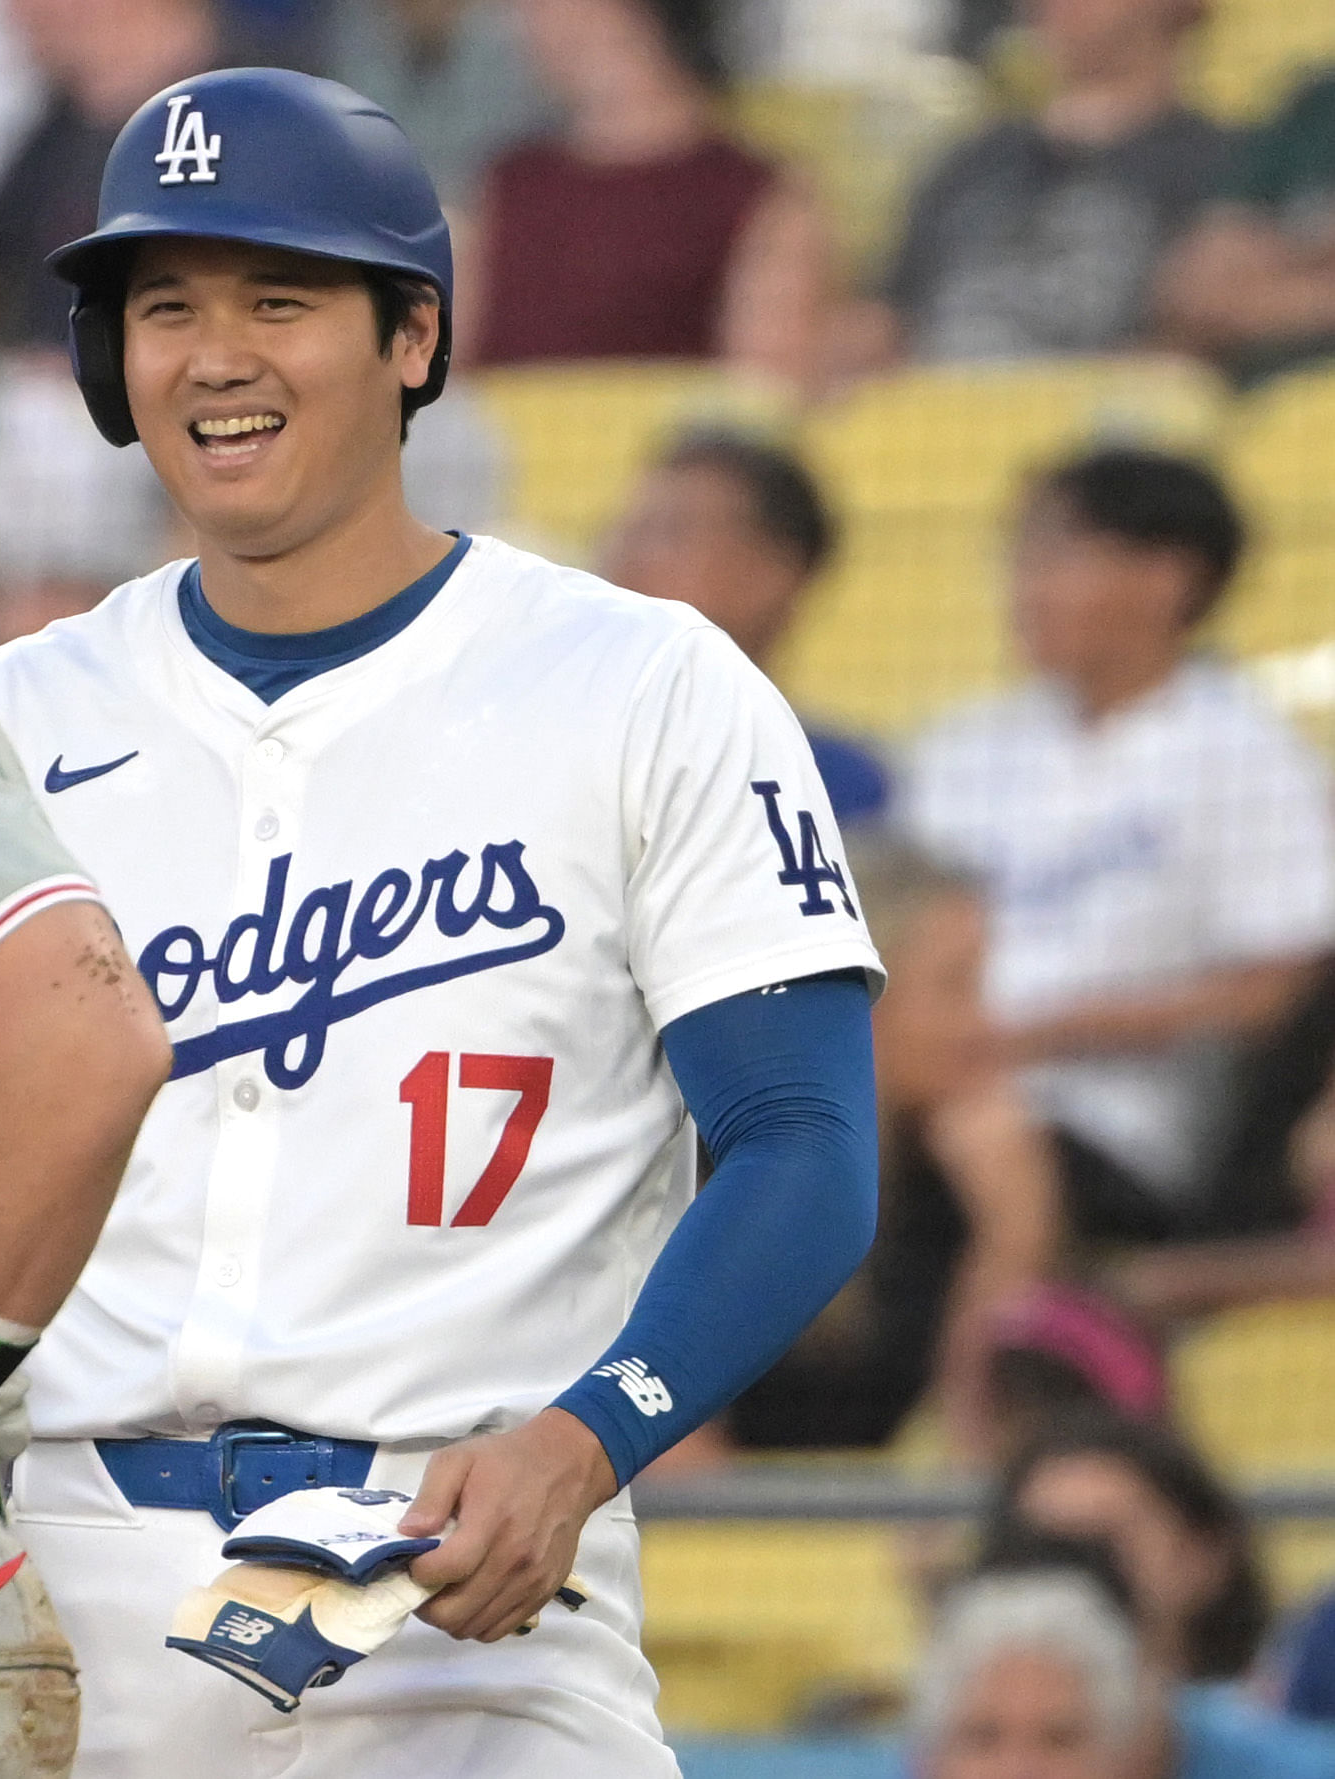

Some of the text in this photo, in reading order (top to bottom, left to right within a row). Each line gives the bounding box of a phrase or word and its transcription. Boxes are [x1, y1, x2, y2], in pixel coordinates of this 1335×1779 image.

[155, 95, 222, 185] LA
[750, 778, 860, 922] LA
[136, 839, 566, 1091] odgers
[399, 1051, 555, 1228] 17
